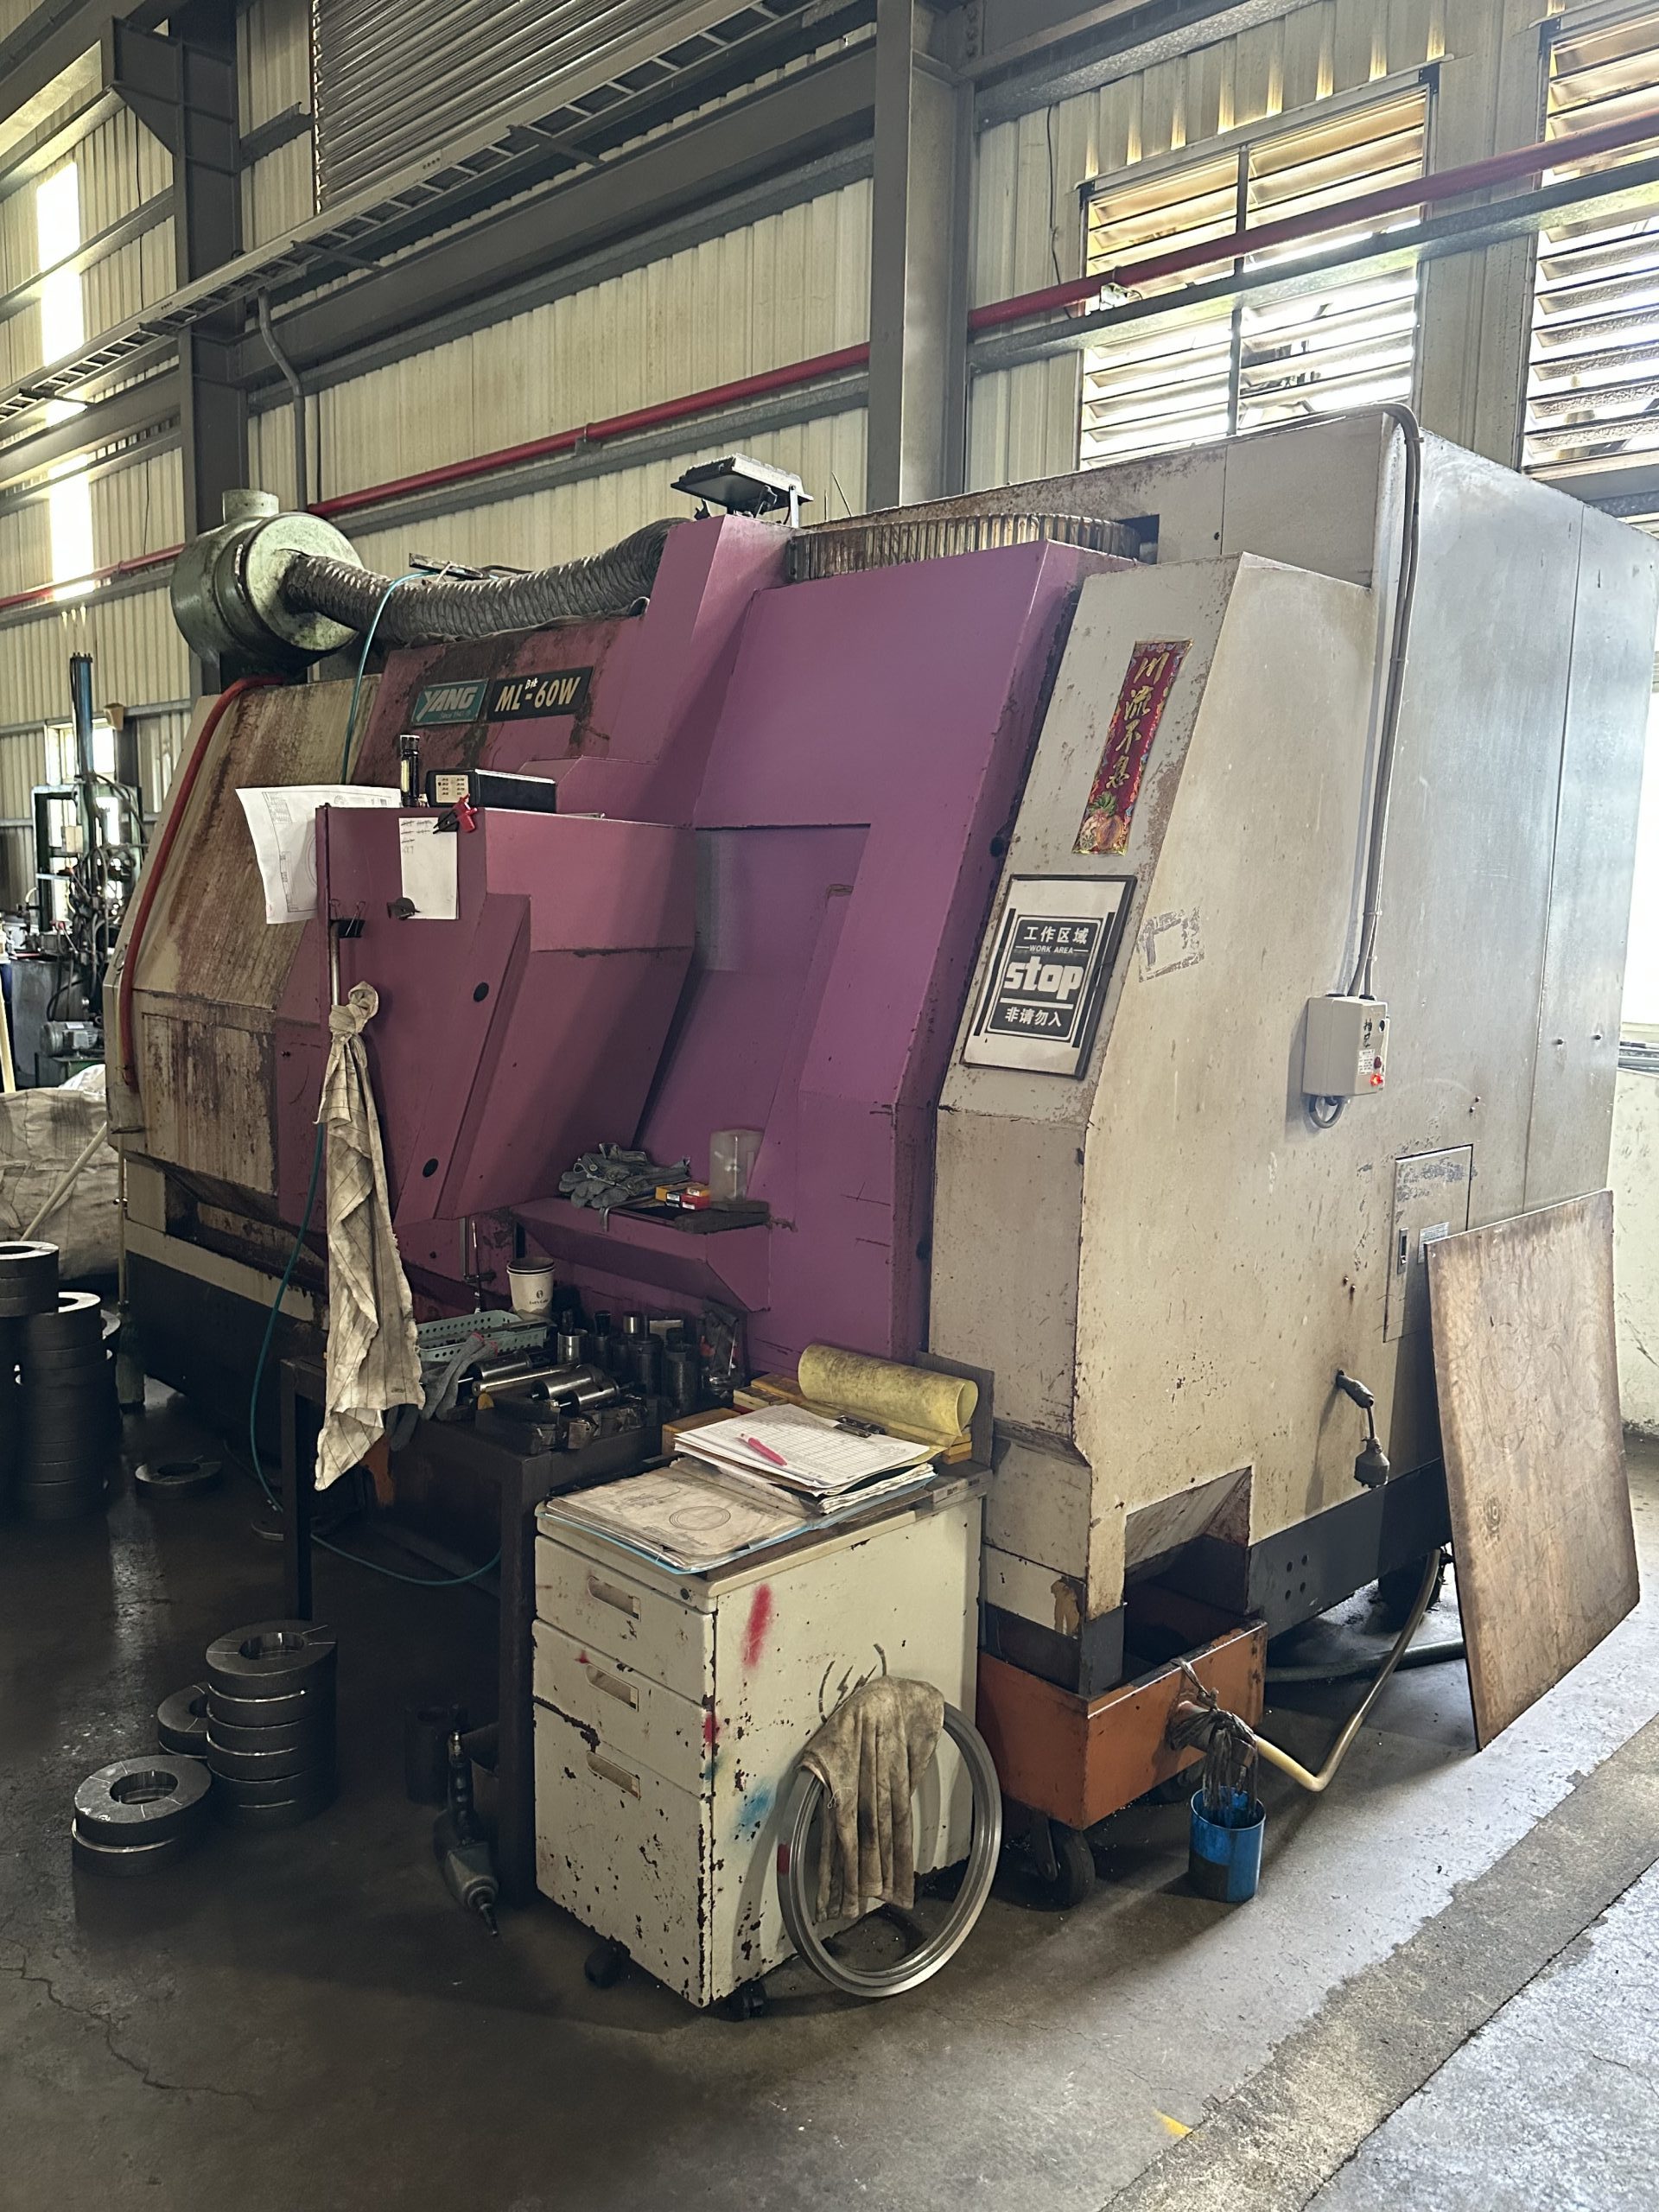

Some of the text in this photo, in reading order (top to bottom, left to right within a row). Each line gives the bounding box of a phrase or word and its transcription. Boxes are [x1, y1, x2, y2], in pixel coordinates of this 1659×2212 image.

[417, 687, 478, 721] YANG
[494, 677, 581, 712] ML-60W
[1105, 650, 1171, 790] 川流不息
[1023, 925, 1090, 944] 工作区域
[1029, 944, 1052, 953] WORK
[1003, 956, 1084, 1001] stop
[1004, 1006, 1062, 1027] 非请勿入
